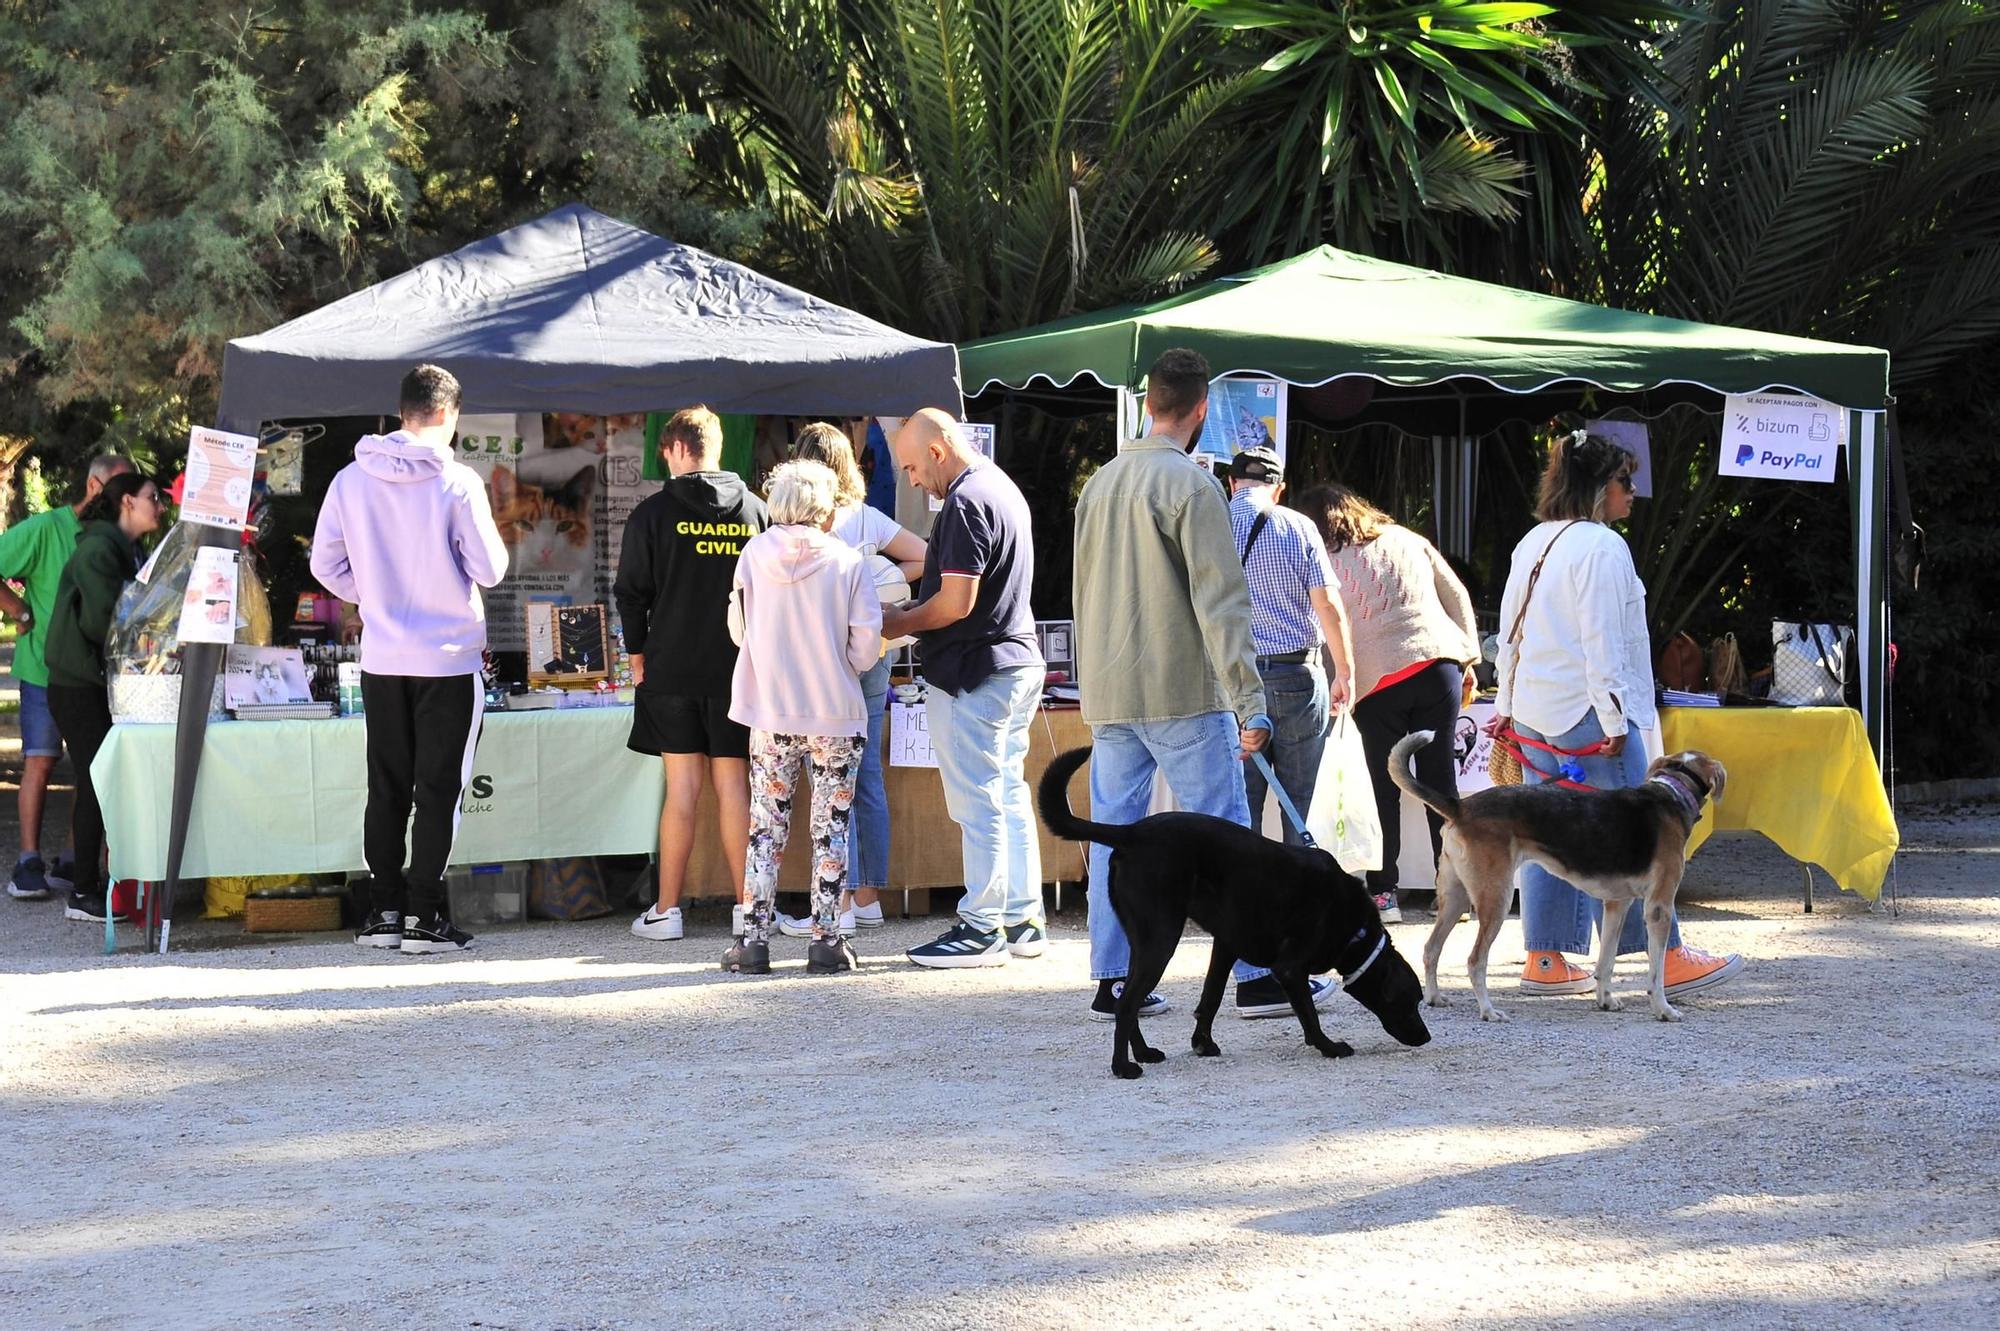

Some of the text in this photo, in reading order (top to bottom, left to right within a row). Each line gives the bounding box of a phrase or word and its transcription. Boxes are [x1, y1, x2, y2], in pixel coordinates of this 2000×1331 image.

[1756, 417, 1799, 434] bizum
[462, 434, 523, 454] CES
[1760, 451, 1822, 469] PayPal
[598, 455, 641, 488] CES
[676, 521, 760, 537] GUARDIA
[695, 541, 741, 555] CIVIL
[463, 801, 493, 813] lche
